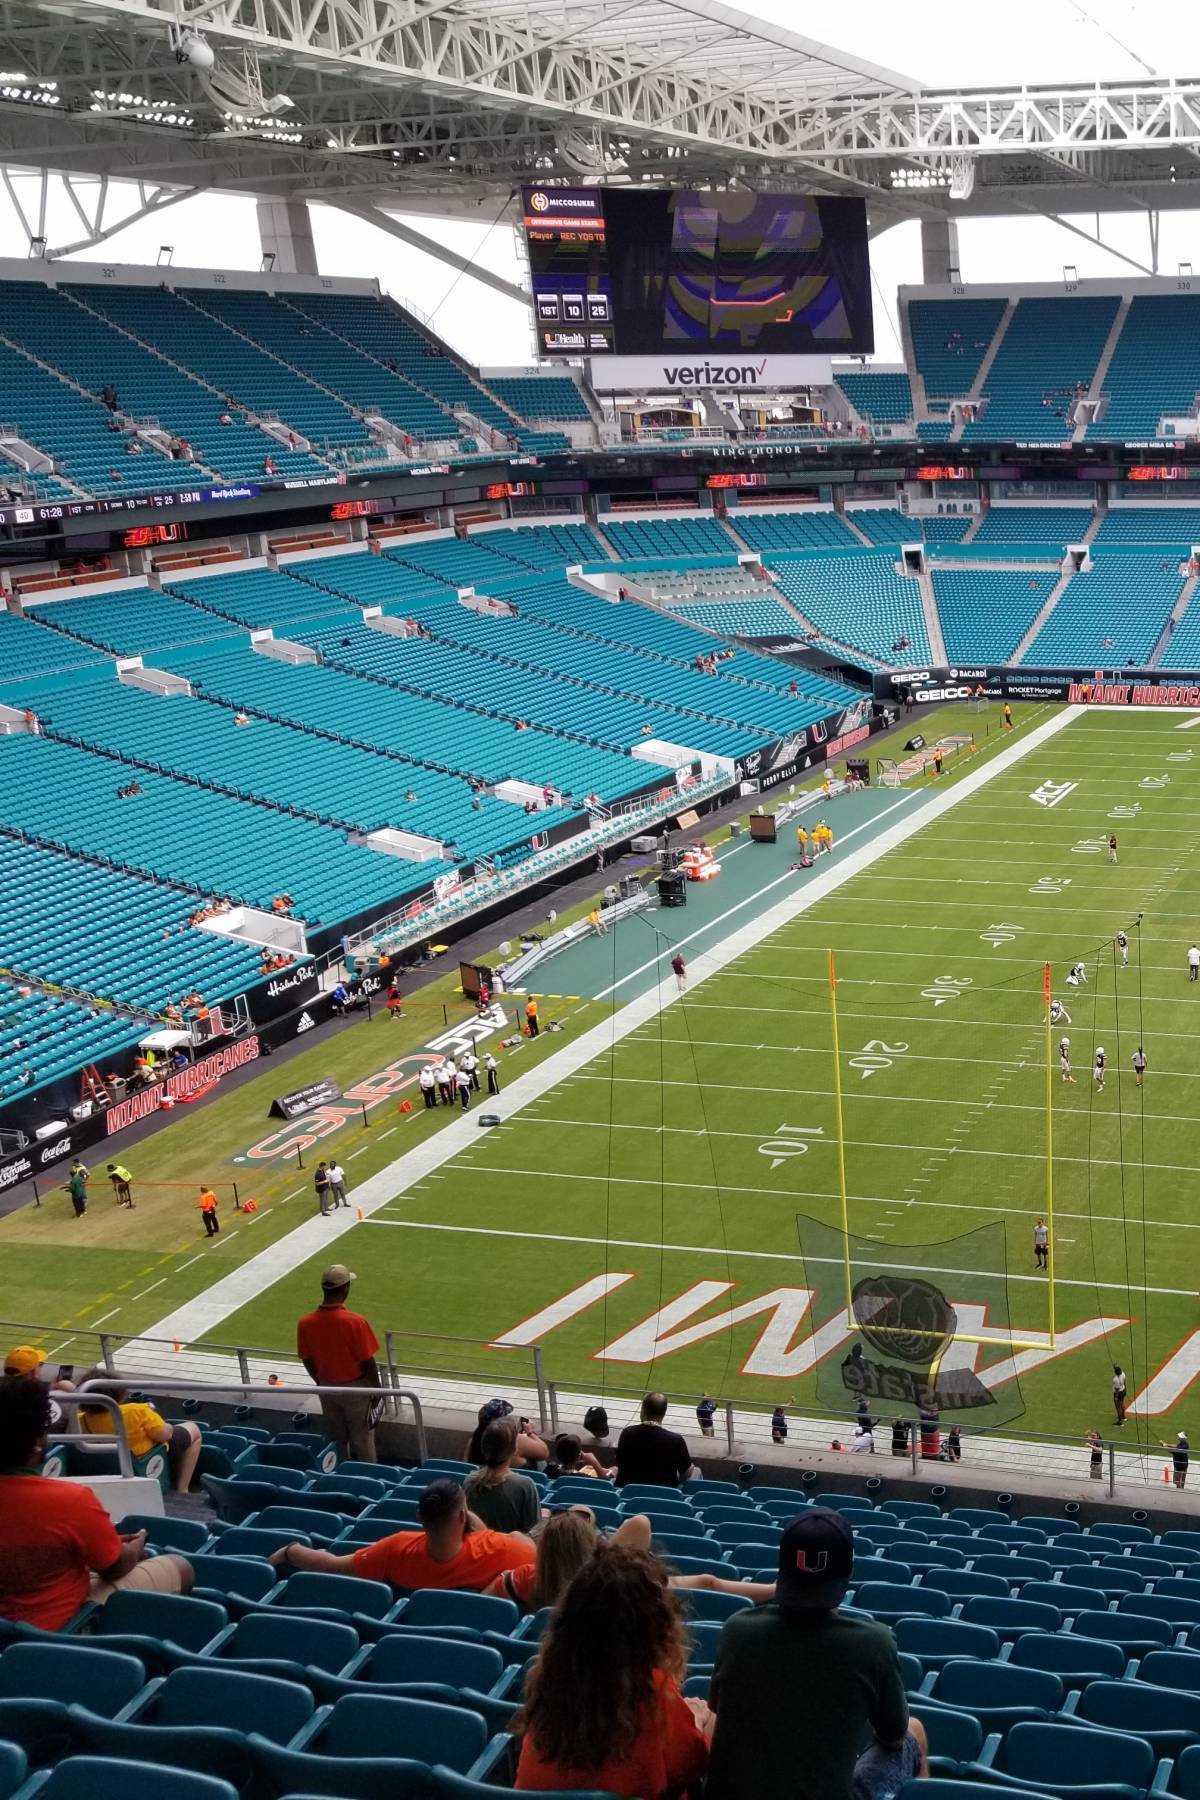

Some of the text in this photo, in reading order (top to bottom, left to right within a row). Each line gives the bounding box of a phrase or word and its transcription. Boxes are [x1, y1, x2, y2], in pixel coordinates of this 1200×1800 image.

[550, 199, 595, 207] MICCOSUKEE
[530, 232, 553, 240] Player
[541, 306, 556, 315] 1ST
[568, 306, 580, 316] 10
[591, 306, 605, 316] 25
[663, 362, 757, 385] verizon
[757, 446, 801, 455] HONOR
[126, 501, 135, 509] 10
[165, 496, 173, 505] 25
[40, 507, 63, 518] 61:28
[891, 672, 930, 683] GEICO
[1068, 683, 1130, 704] MIAMI
[1166, 751, 1194, 762] 10
[762, 765, 797, 787] PERRY ELLIS
[1138, 776, 1171, 788] 20
[1028, 780, 1072, 807] ACC
[1106, 804, 1142, 818] 30
[1071, 837, 1108, 853] 40
[1028, 877, 1072, 894] 50
[980, 923, 1024, 940] 40
[297, 966, 315, 982] Park
[362, 977, 380, 994] Park
[920, 975, 974, 998] 30
[848, 1039, 910, 1069] 20
[107, 1082, 164, 1136] MIAMI
[166, 1035, 260, 1100] HURRICANES
[757, 1122, 825, 1157] 10
[797, 1550, 828, 1573] U
